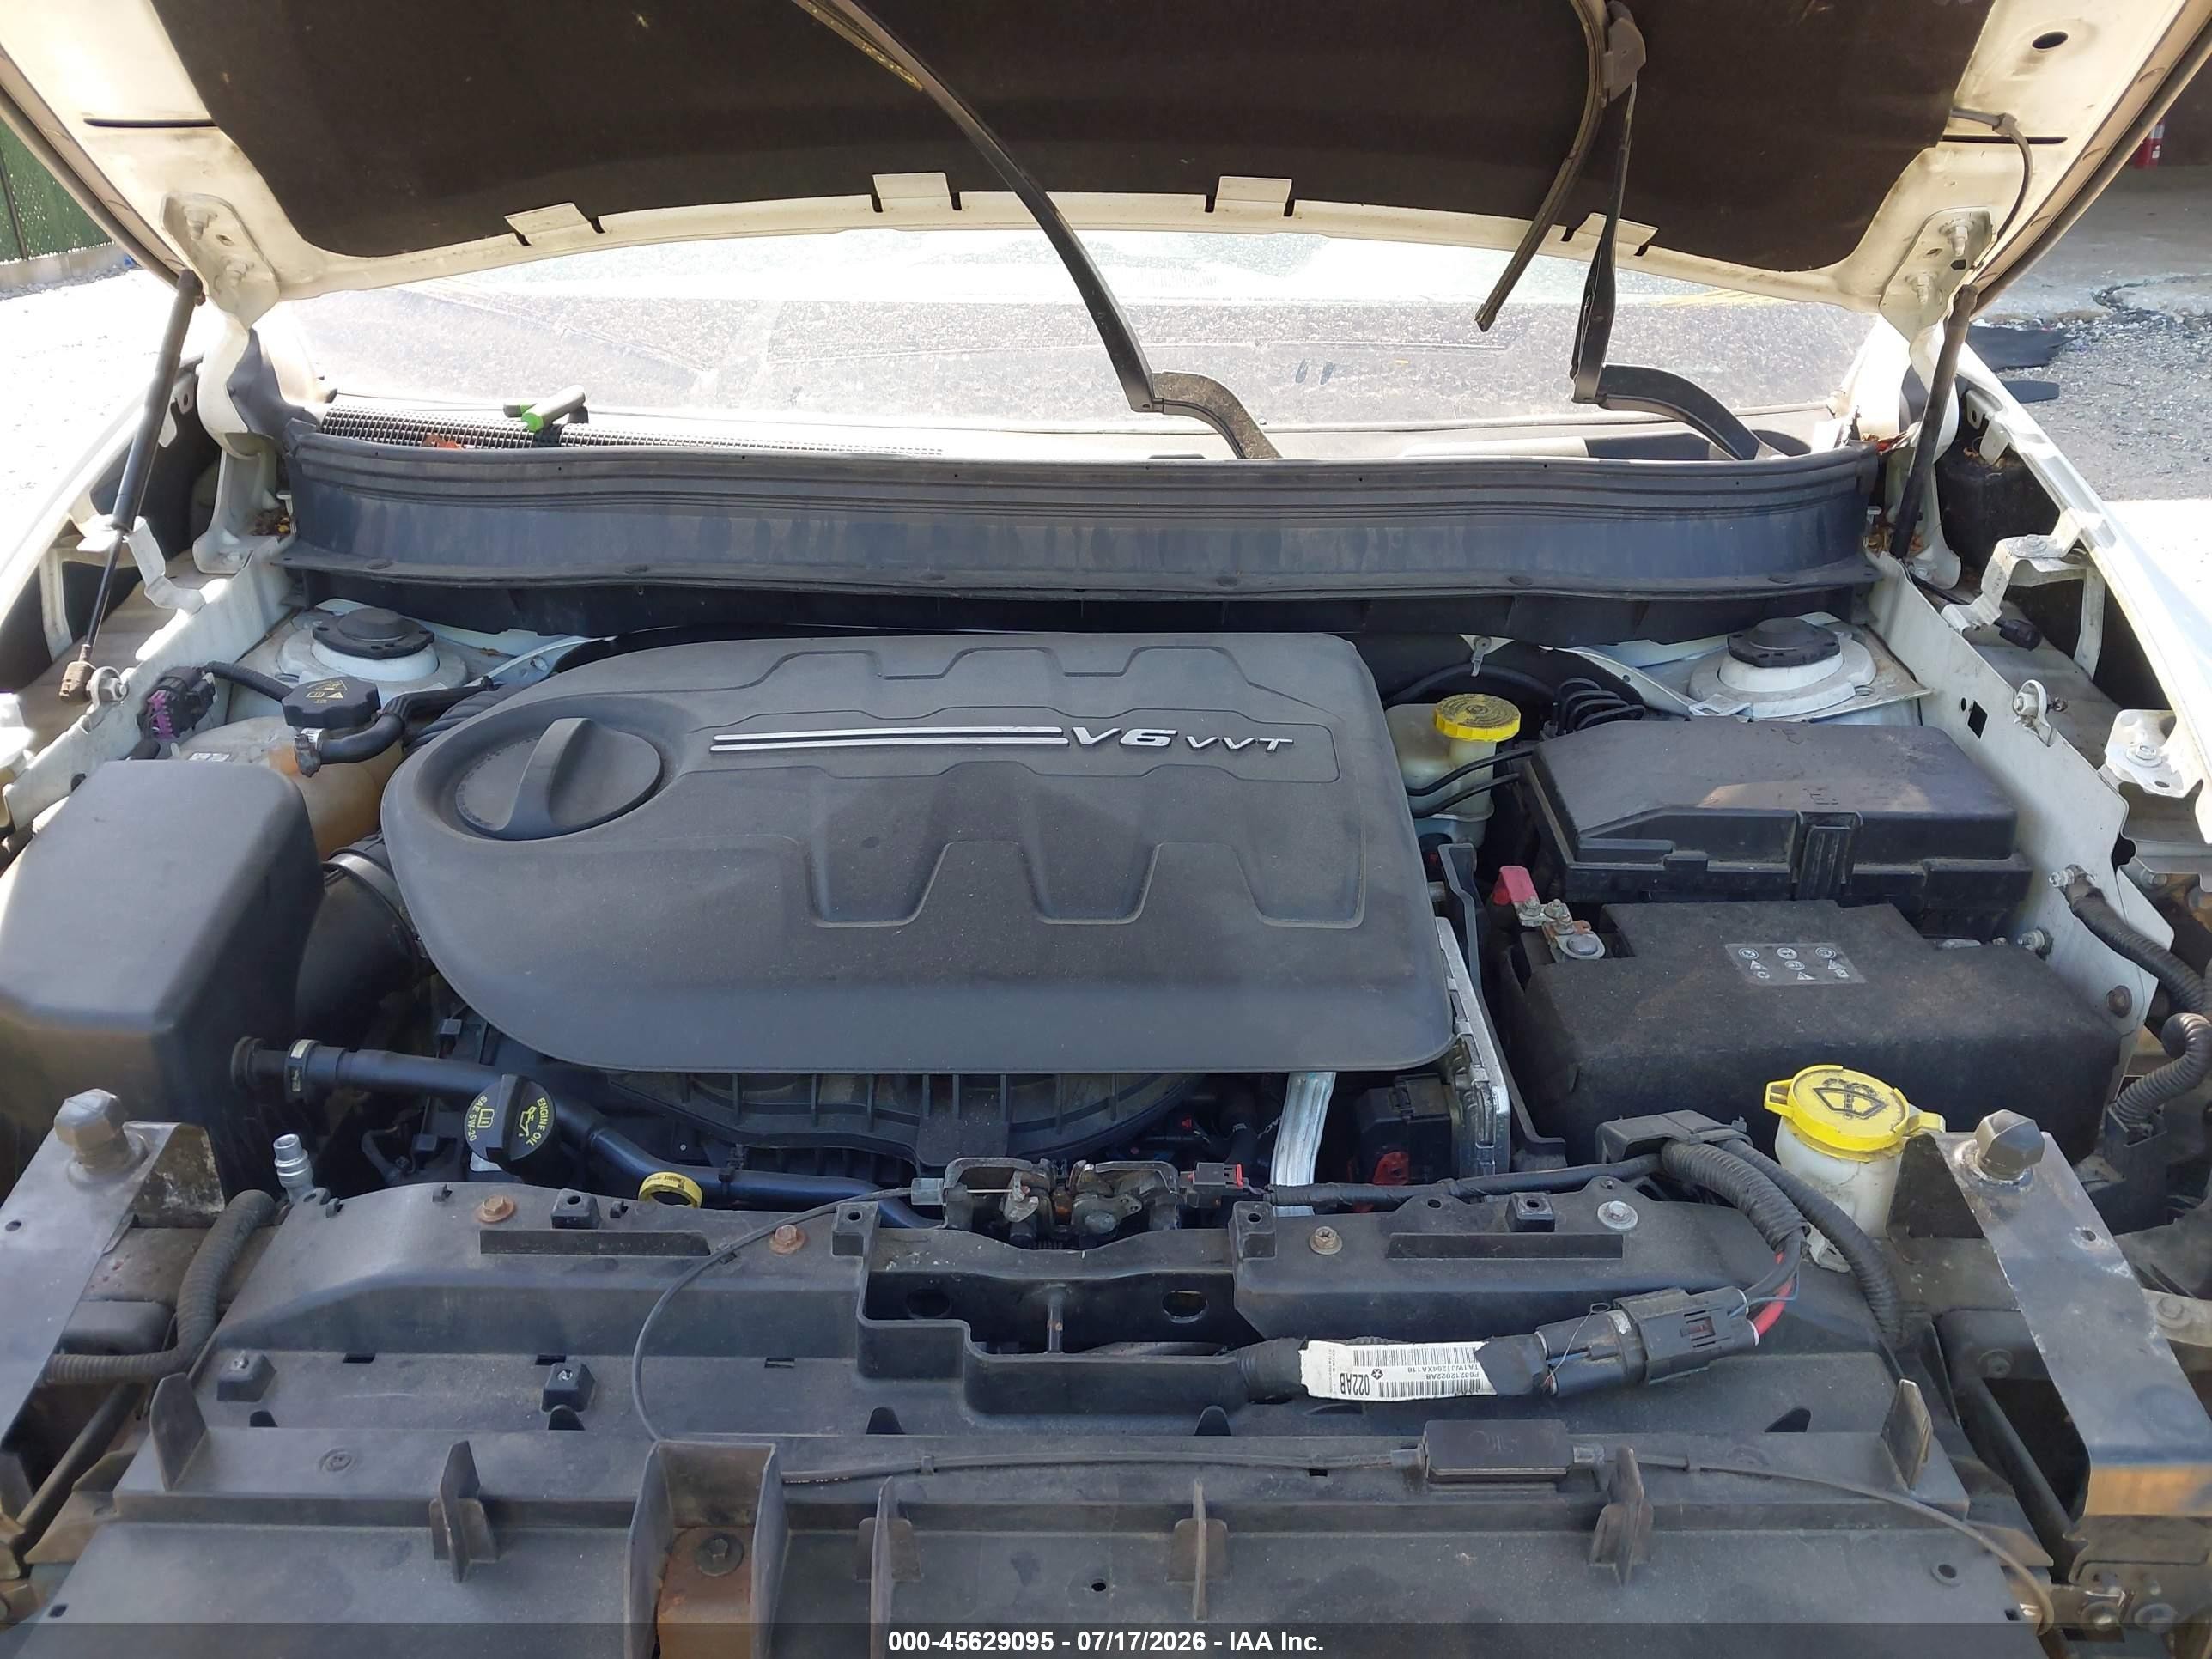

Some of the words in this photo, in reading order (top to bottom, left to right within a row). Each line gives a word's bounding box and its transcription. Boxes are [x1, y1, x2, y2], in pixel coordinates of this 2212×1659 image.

[1072, 726, 1179, 748] V6
[1186, 736, 1294, 752] VVT
[472, 1095, 488, 1111] SAE
[537, 1097, 548, 1131] ENGINE
[467, 1114, 477, 1142] 5W-20
[526, 1132, 542, 1146] OIL
[1340, 1373, 1370, 1395] 022AB
